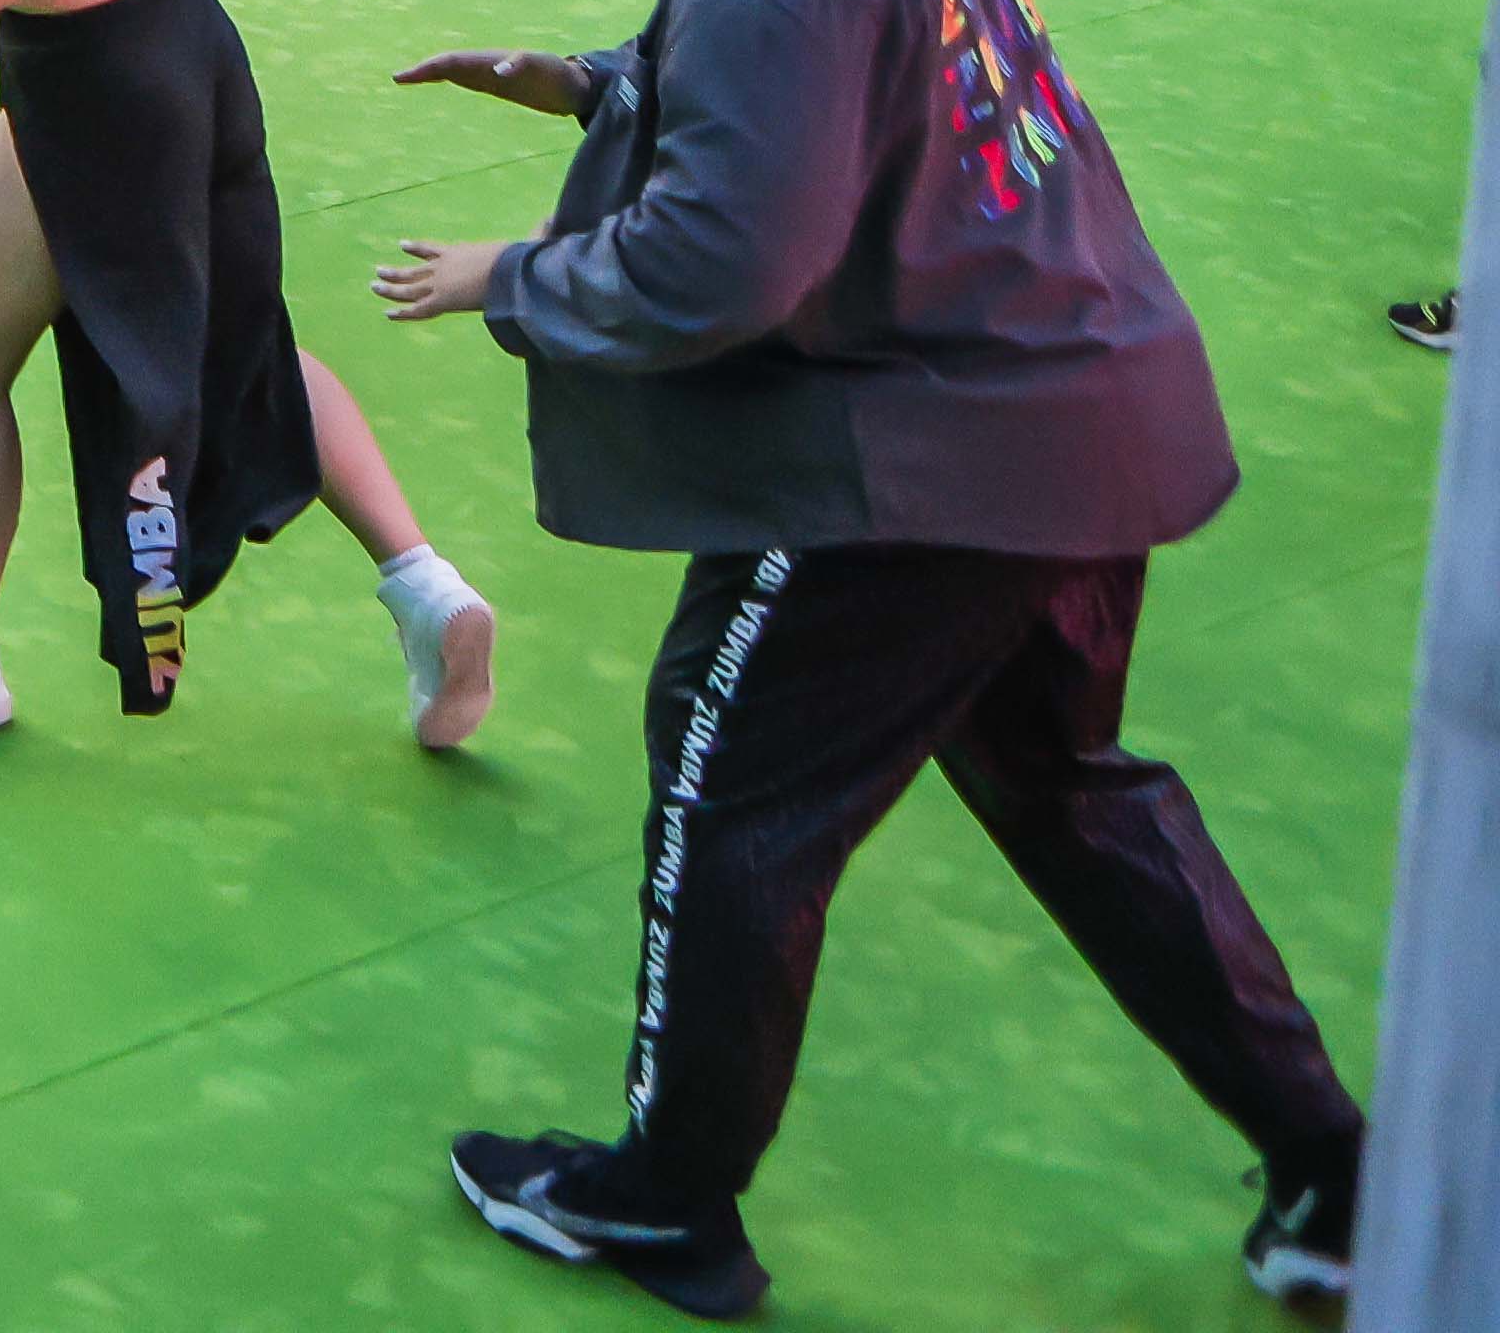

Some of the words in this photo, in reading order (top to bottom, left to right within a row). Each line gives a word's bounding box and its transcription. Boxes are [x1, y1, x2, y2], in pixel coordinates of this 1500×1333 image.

[706, 599, 770, 702] ZUMBA
[668, 695, 720, 802] ZUMBA
[652, 804, 686, 916] ZUMBA
